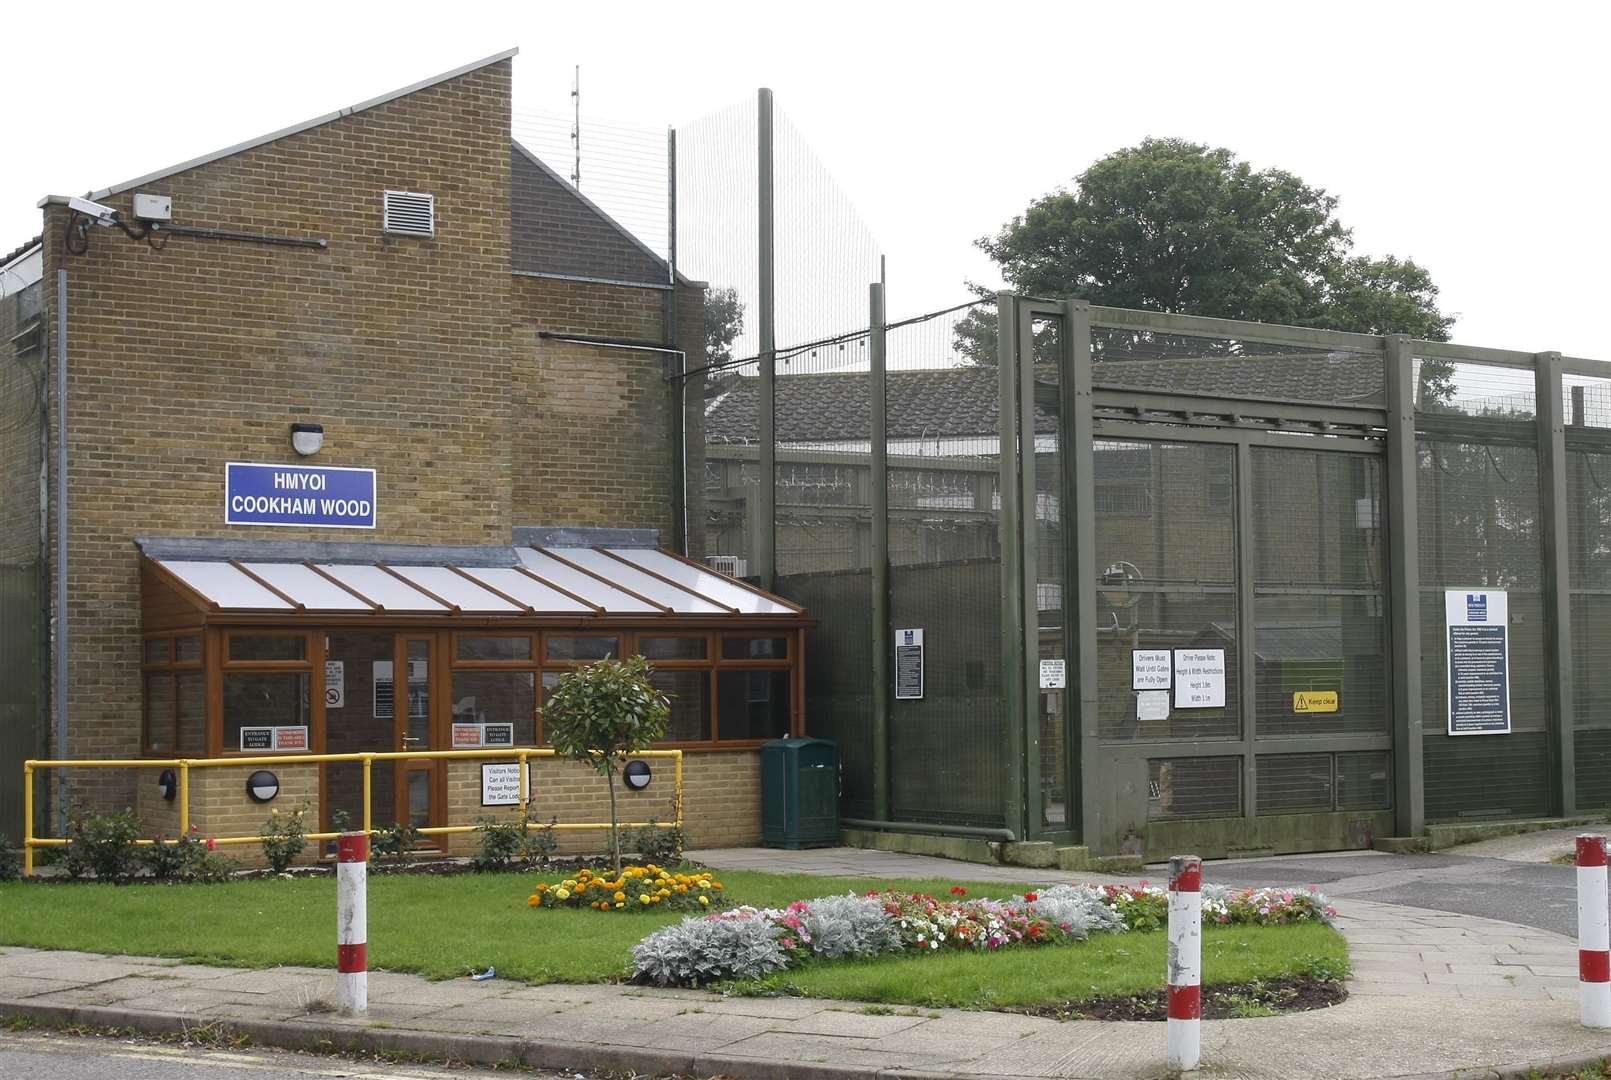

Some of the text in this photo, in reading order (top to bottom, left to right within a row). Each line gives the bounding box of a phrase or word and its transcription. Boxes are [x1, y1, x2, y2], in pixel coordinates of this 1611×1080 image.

[274, 472, 326, 490] HMYOI
[232, 495, 371, 517] COOKHAM WOOD
[1138, 654, 1154, 662] Drivers
[1145, 676, 1156, 684] Fully
[1156, 675, 1168, 684] Open
